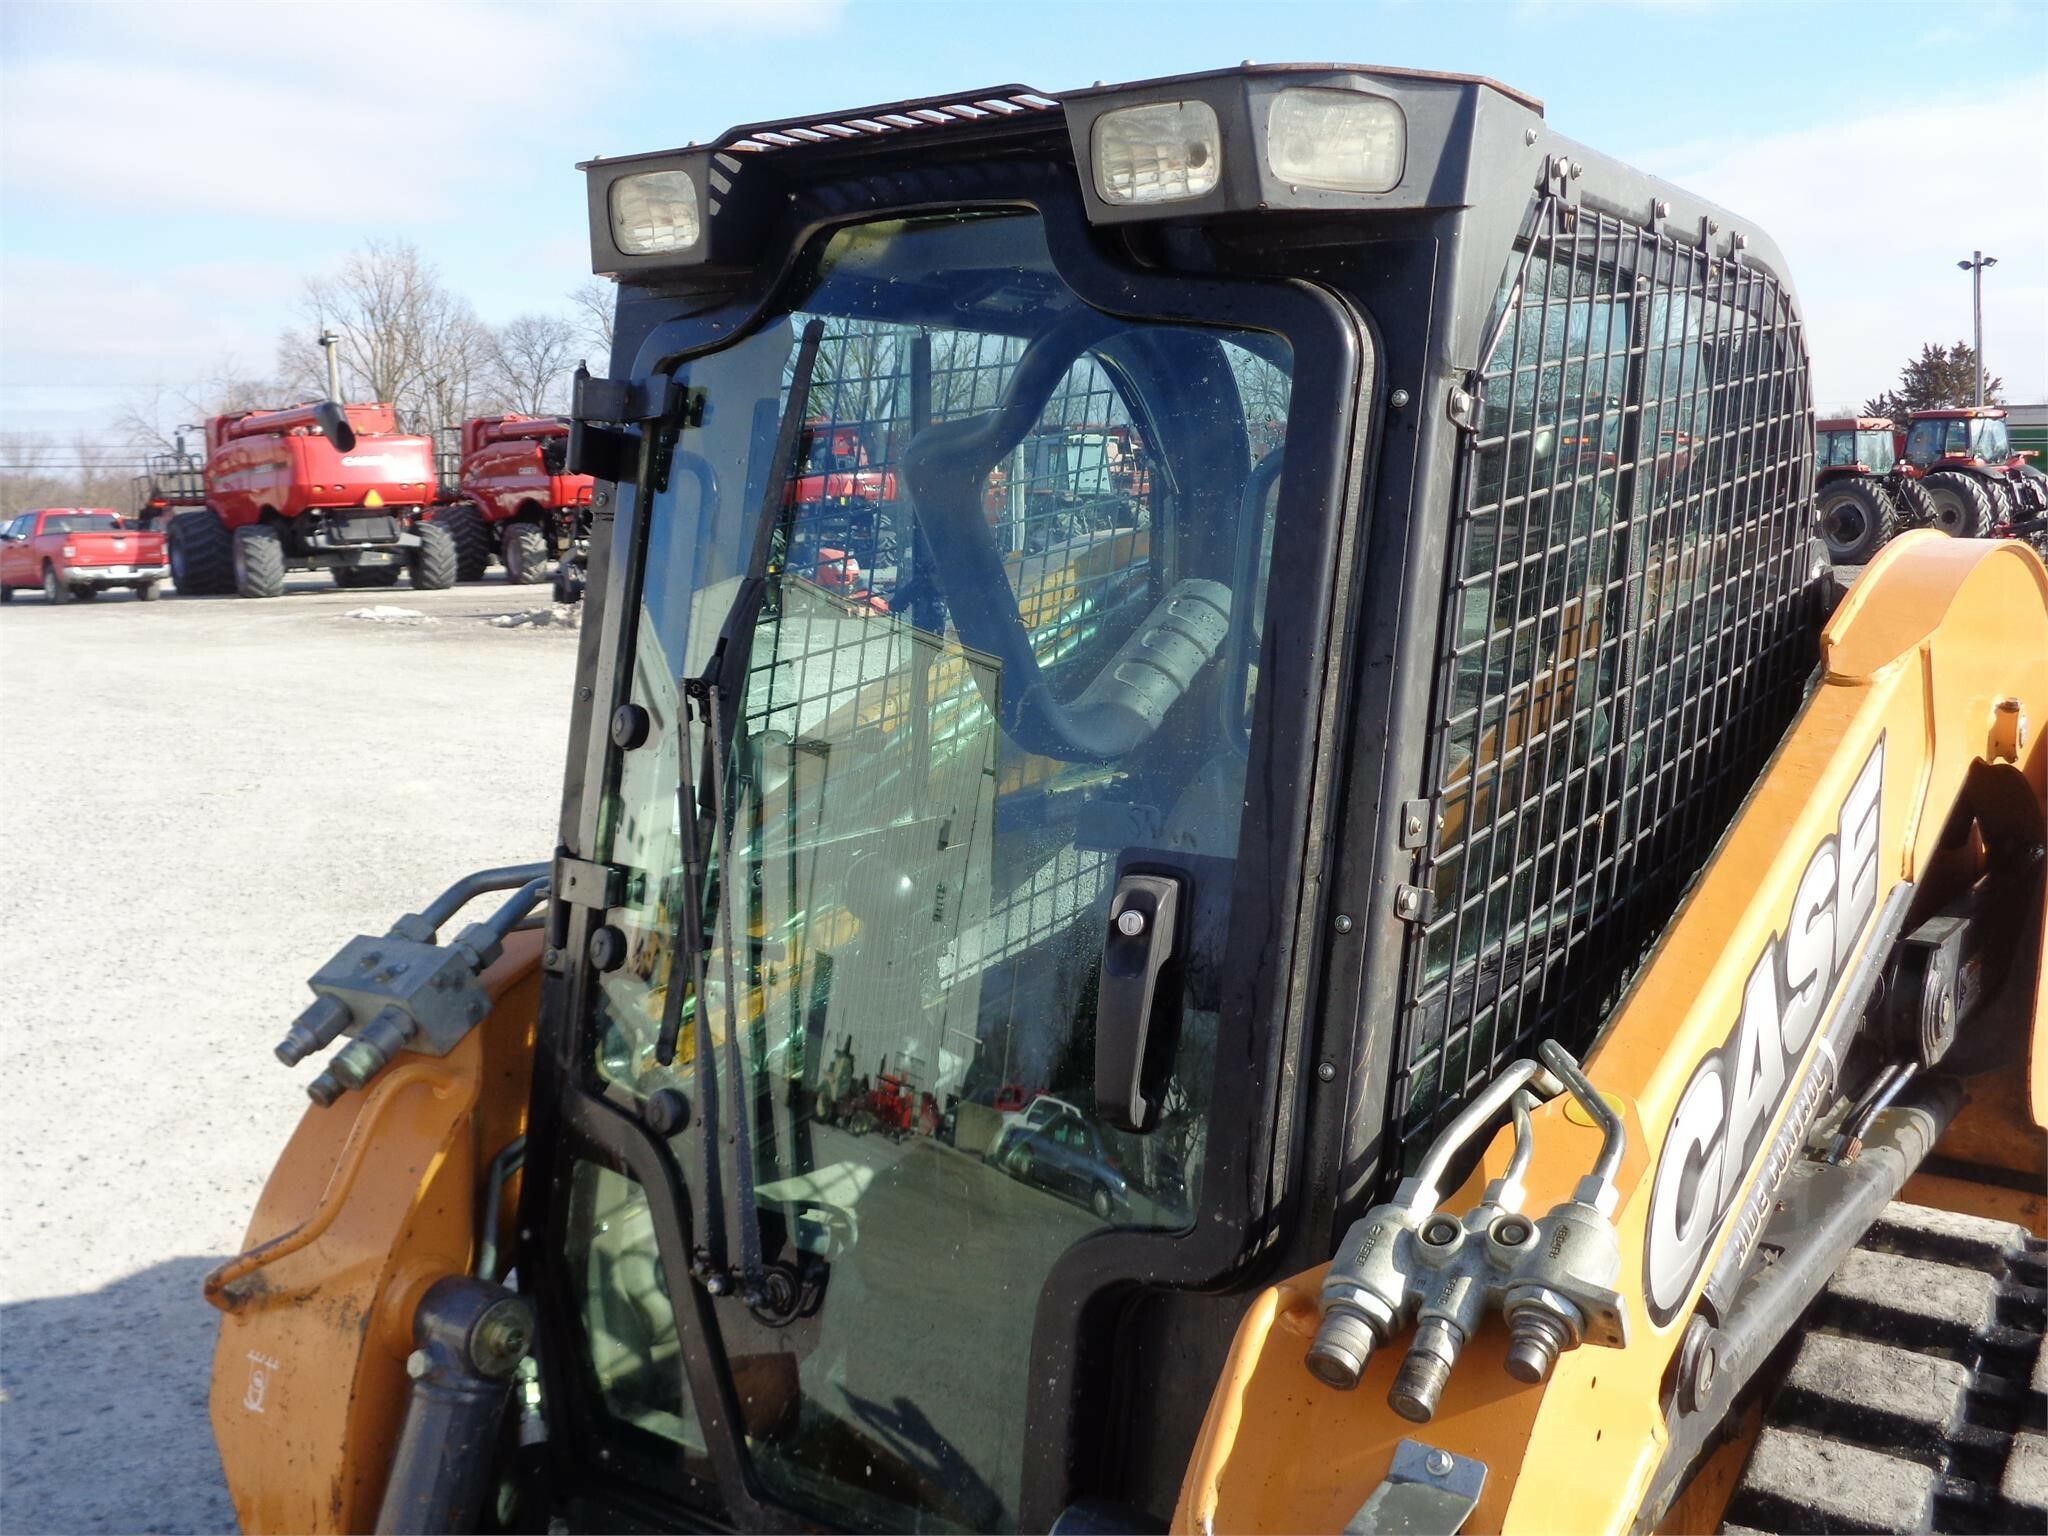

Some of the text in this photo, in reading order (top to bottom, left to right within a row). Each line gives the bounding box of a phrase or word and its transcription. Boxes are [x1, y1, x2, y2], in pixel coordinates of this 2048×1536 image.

[1645, 732, 1884, 1322] CASE
[1734, 1062, 1828, 1272] RIDE CONTROL
